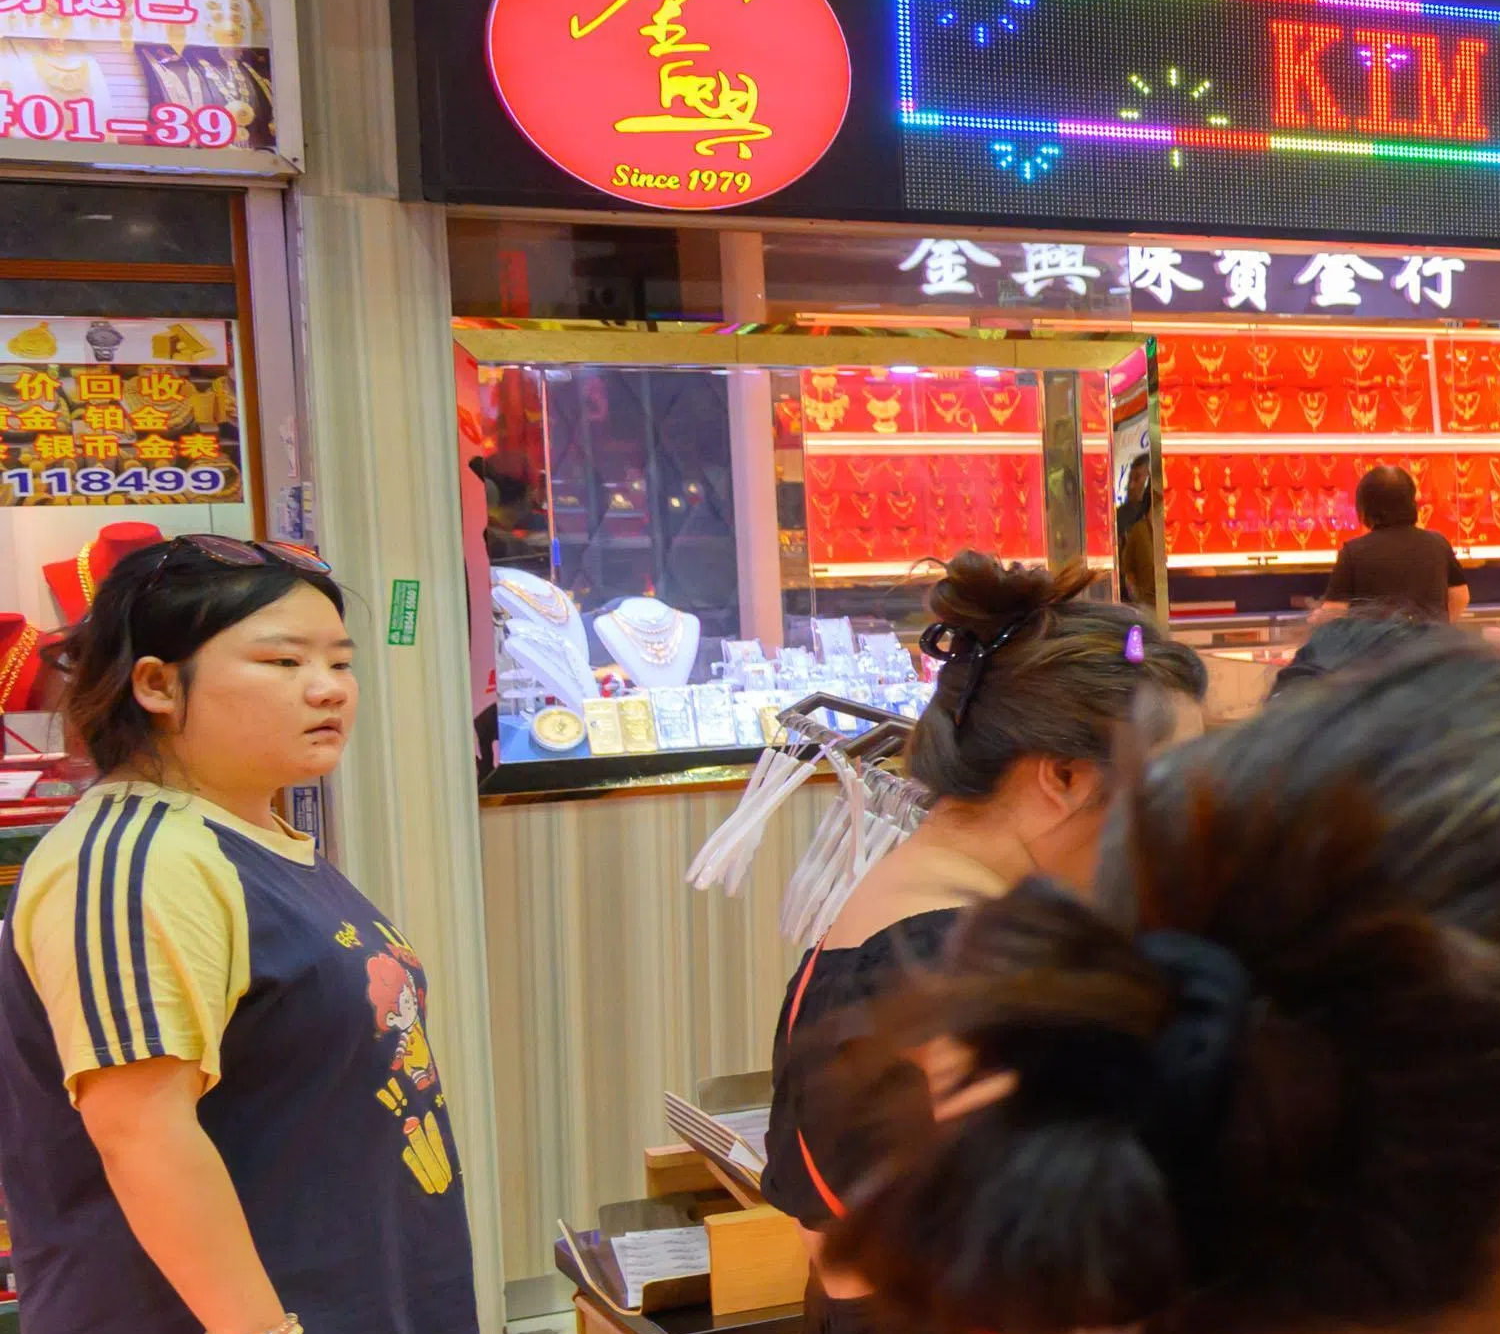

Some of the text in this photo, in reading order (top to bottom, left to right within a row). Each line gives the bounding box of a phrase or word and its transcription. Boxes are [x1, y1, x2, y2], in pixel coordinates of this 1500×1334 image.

[1269, 18, 1490, 141] KIM
[611, 164, 752, 194] Since 1979
